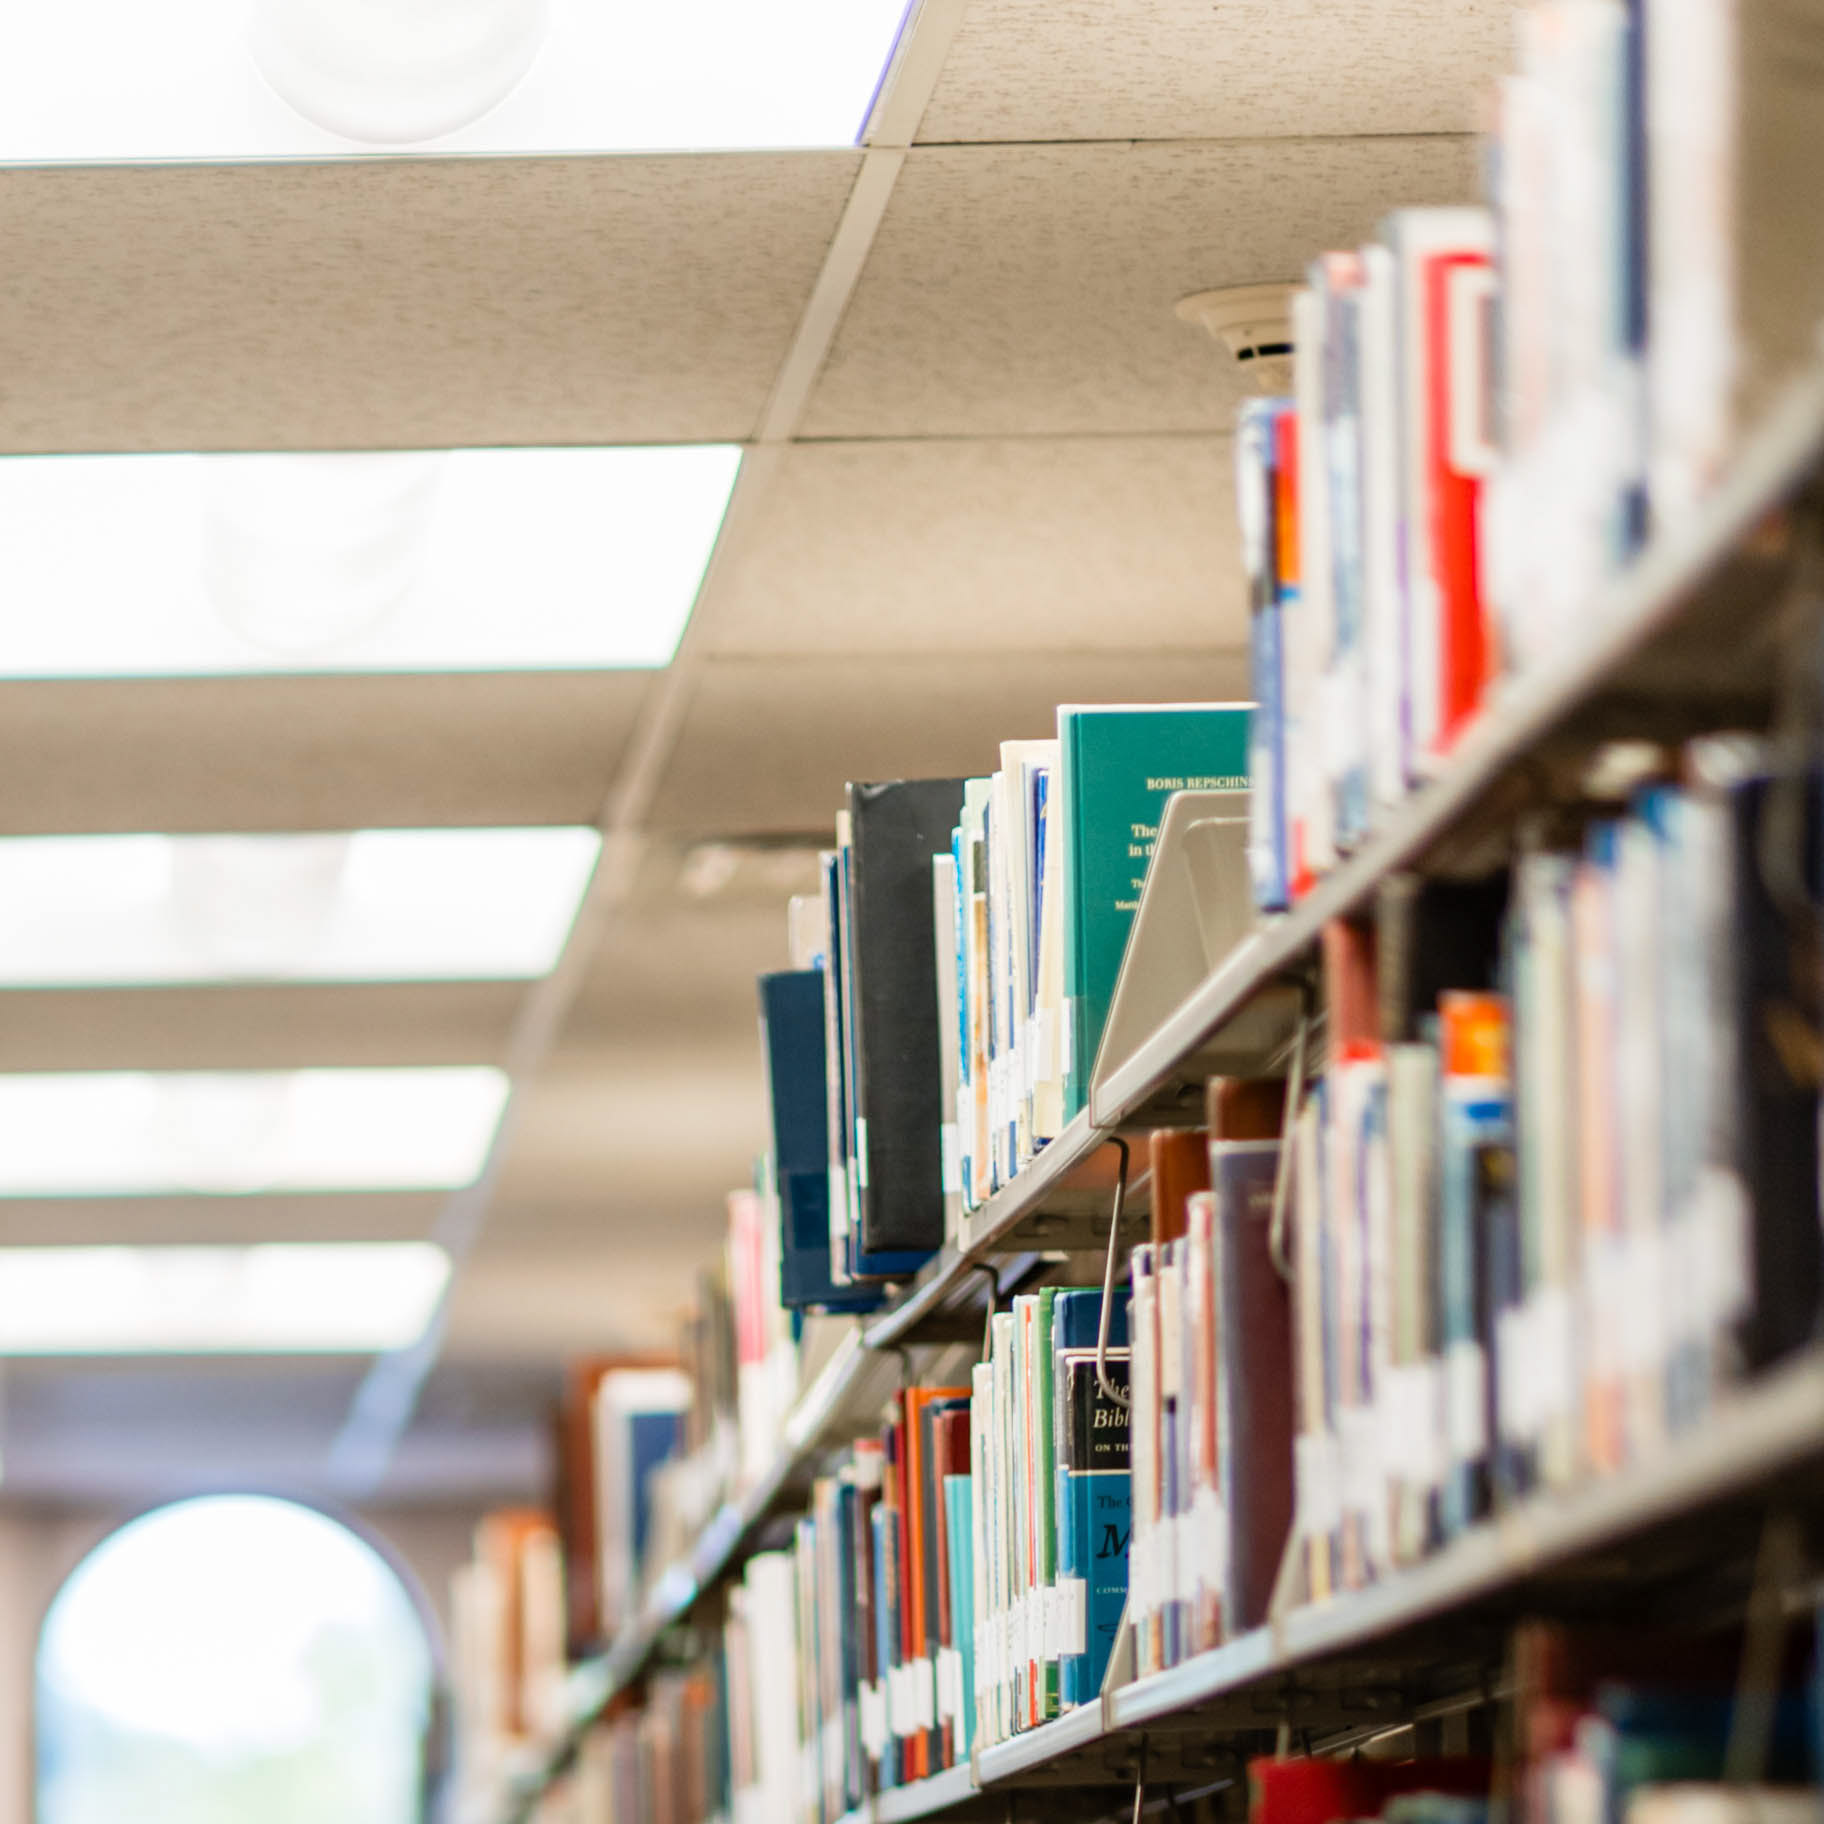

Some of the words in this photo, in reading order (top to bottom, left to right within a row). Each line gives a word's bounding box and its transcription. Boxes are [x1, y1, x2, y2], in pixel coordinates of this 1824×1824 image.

[1146, 776, 1184, 790] BORIS
[1131, 823, 1158, 838] The
[1129, 843, 1142, 857] in
[1095, 1443, 1110, 1452] ON
[1097, 1495, 1122, 1510] The
